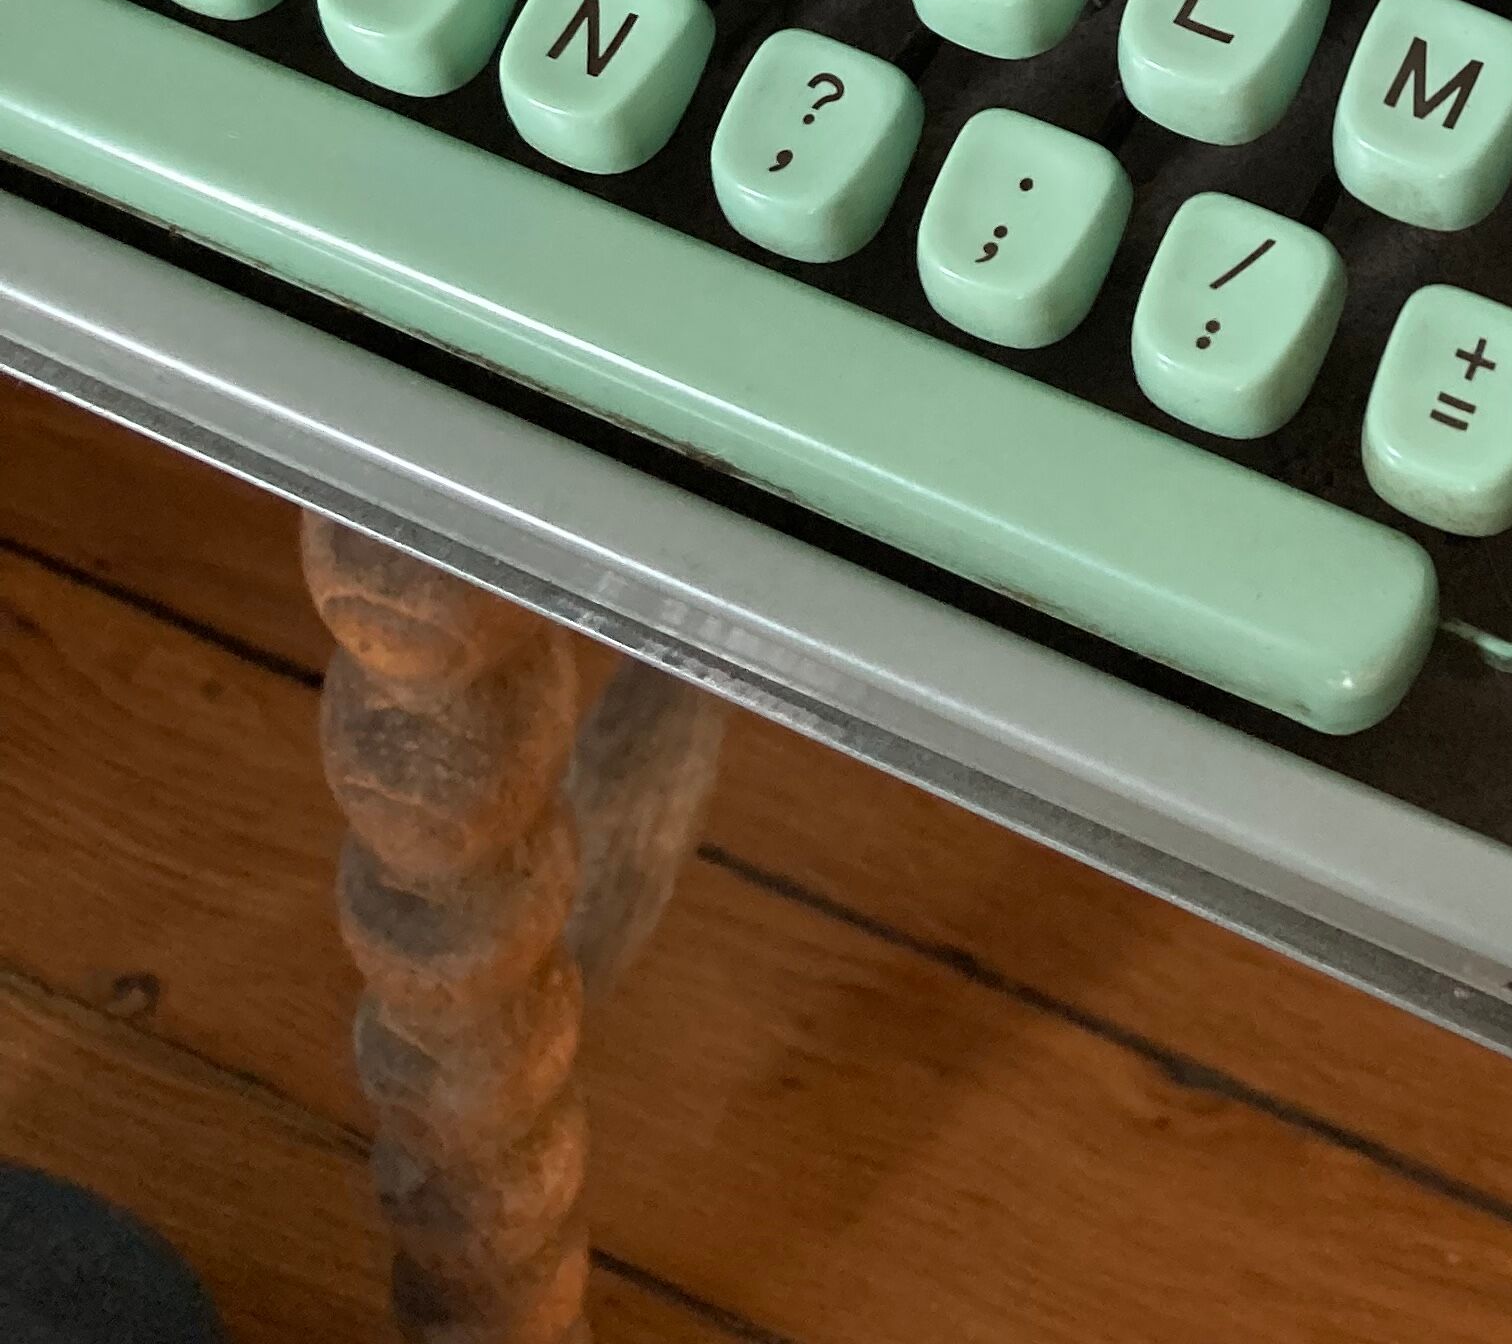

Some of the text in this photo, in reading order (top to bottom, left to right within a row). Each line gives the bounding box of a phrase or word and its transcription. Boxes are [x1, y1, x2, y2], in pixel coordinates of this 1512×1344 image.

[801, 71, 847, 128] ?
[1382, 35, 1486, 131] M
[1454, 337, 1497, 382] +
[1428, 390, 1479, 433] =
